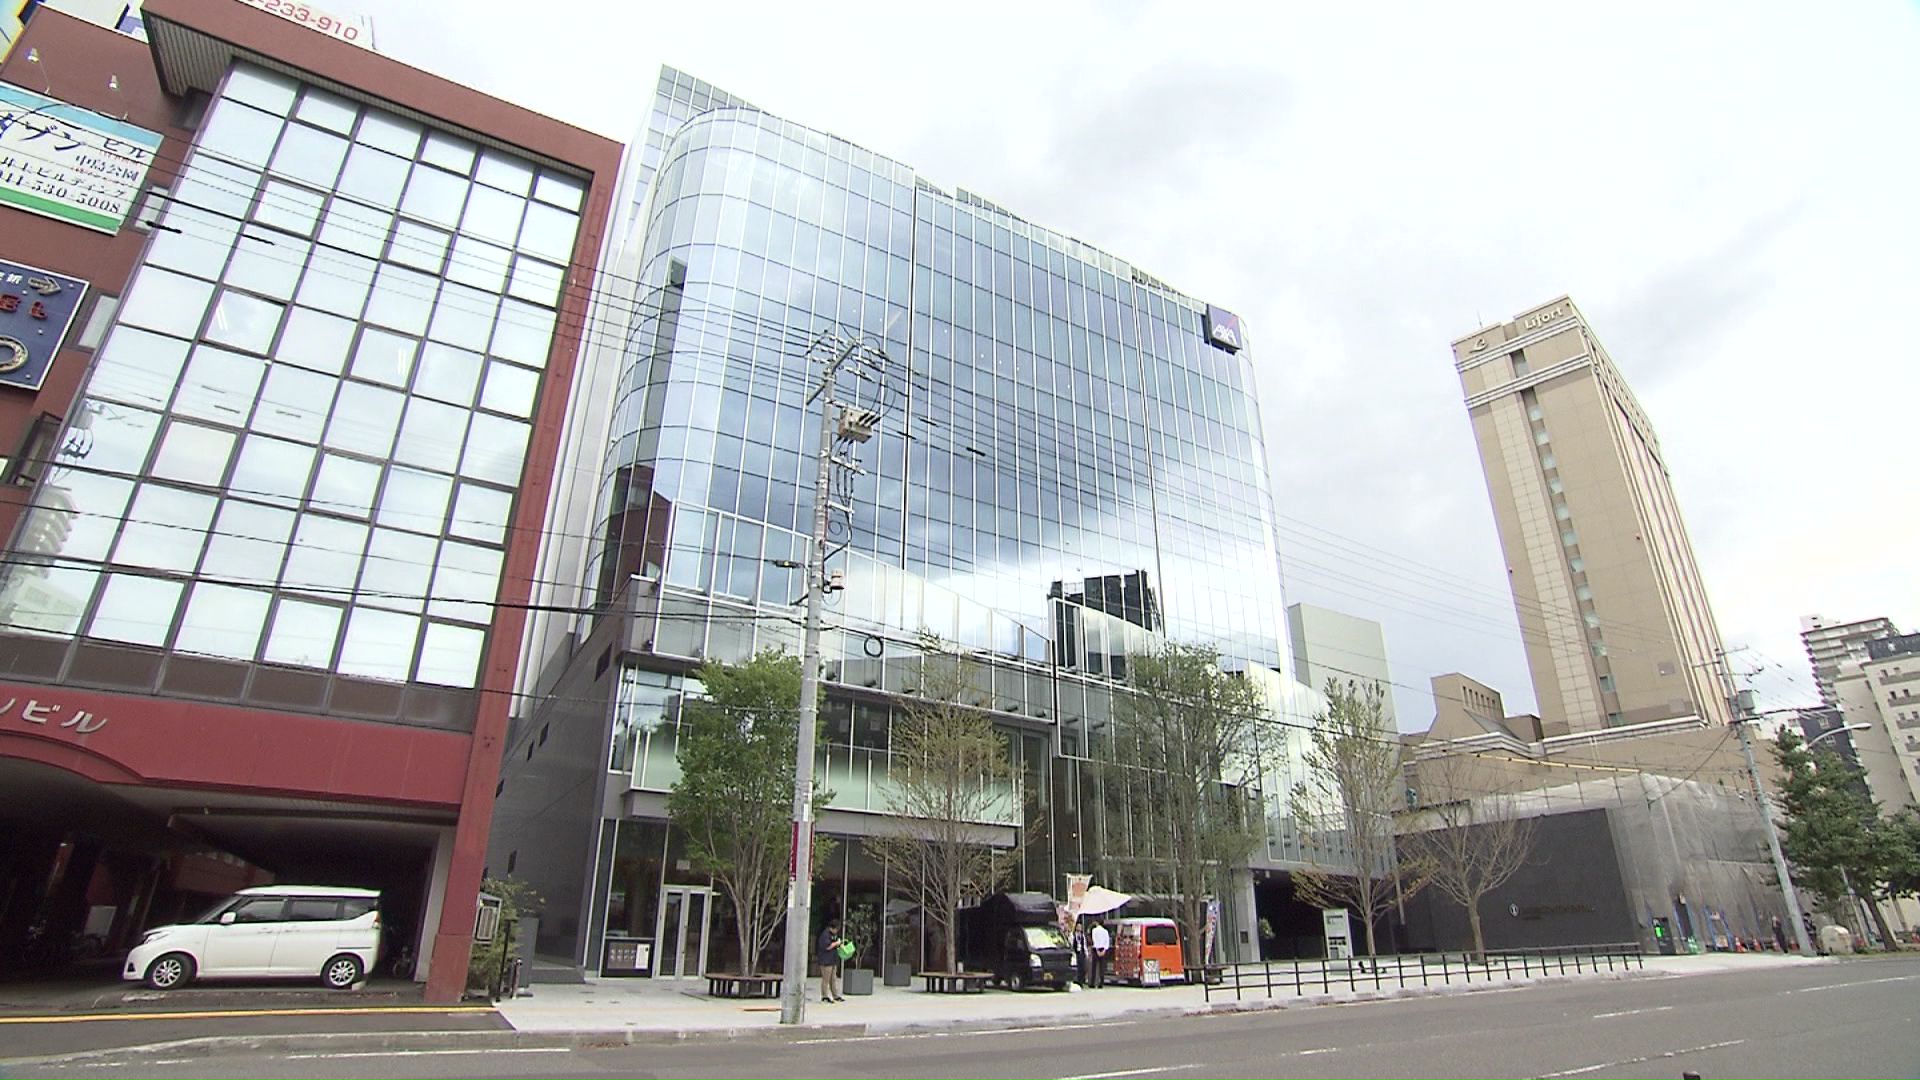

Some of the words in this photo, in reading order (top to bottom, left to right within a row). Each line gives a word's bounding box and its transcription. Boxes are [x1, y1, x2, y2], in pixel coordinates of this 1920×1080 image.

[258, 0, 358, 41] -233-910
[1524, 307, 1563, 330] Lifort
[1212, 323, 1238, 346] AXA
